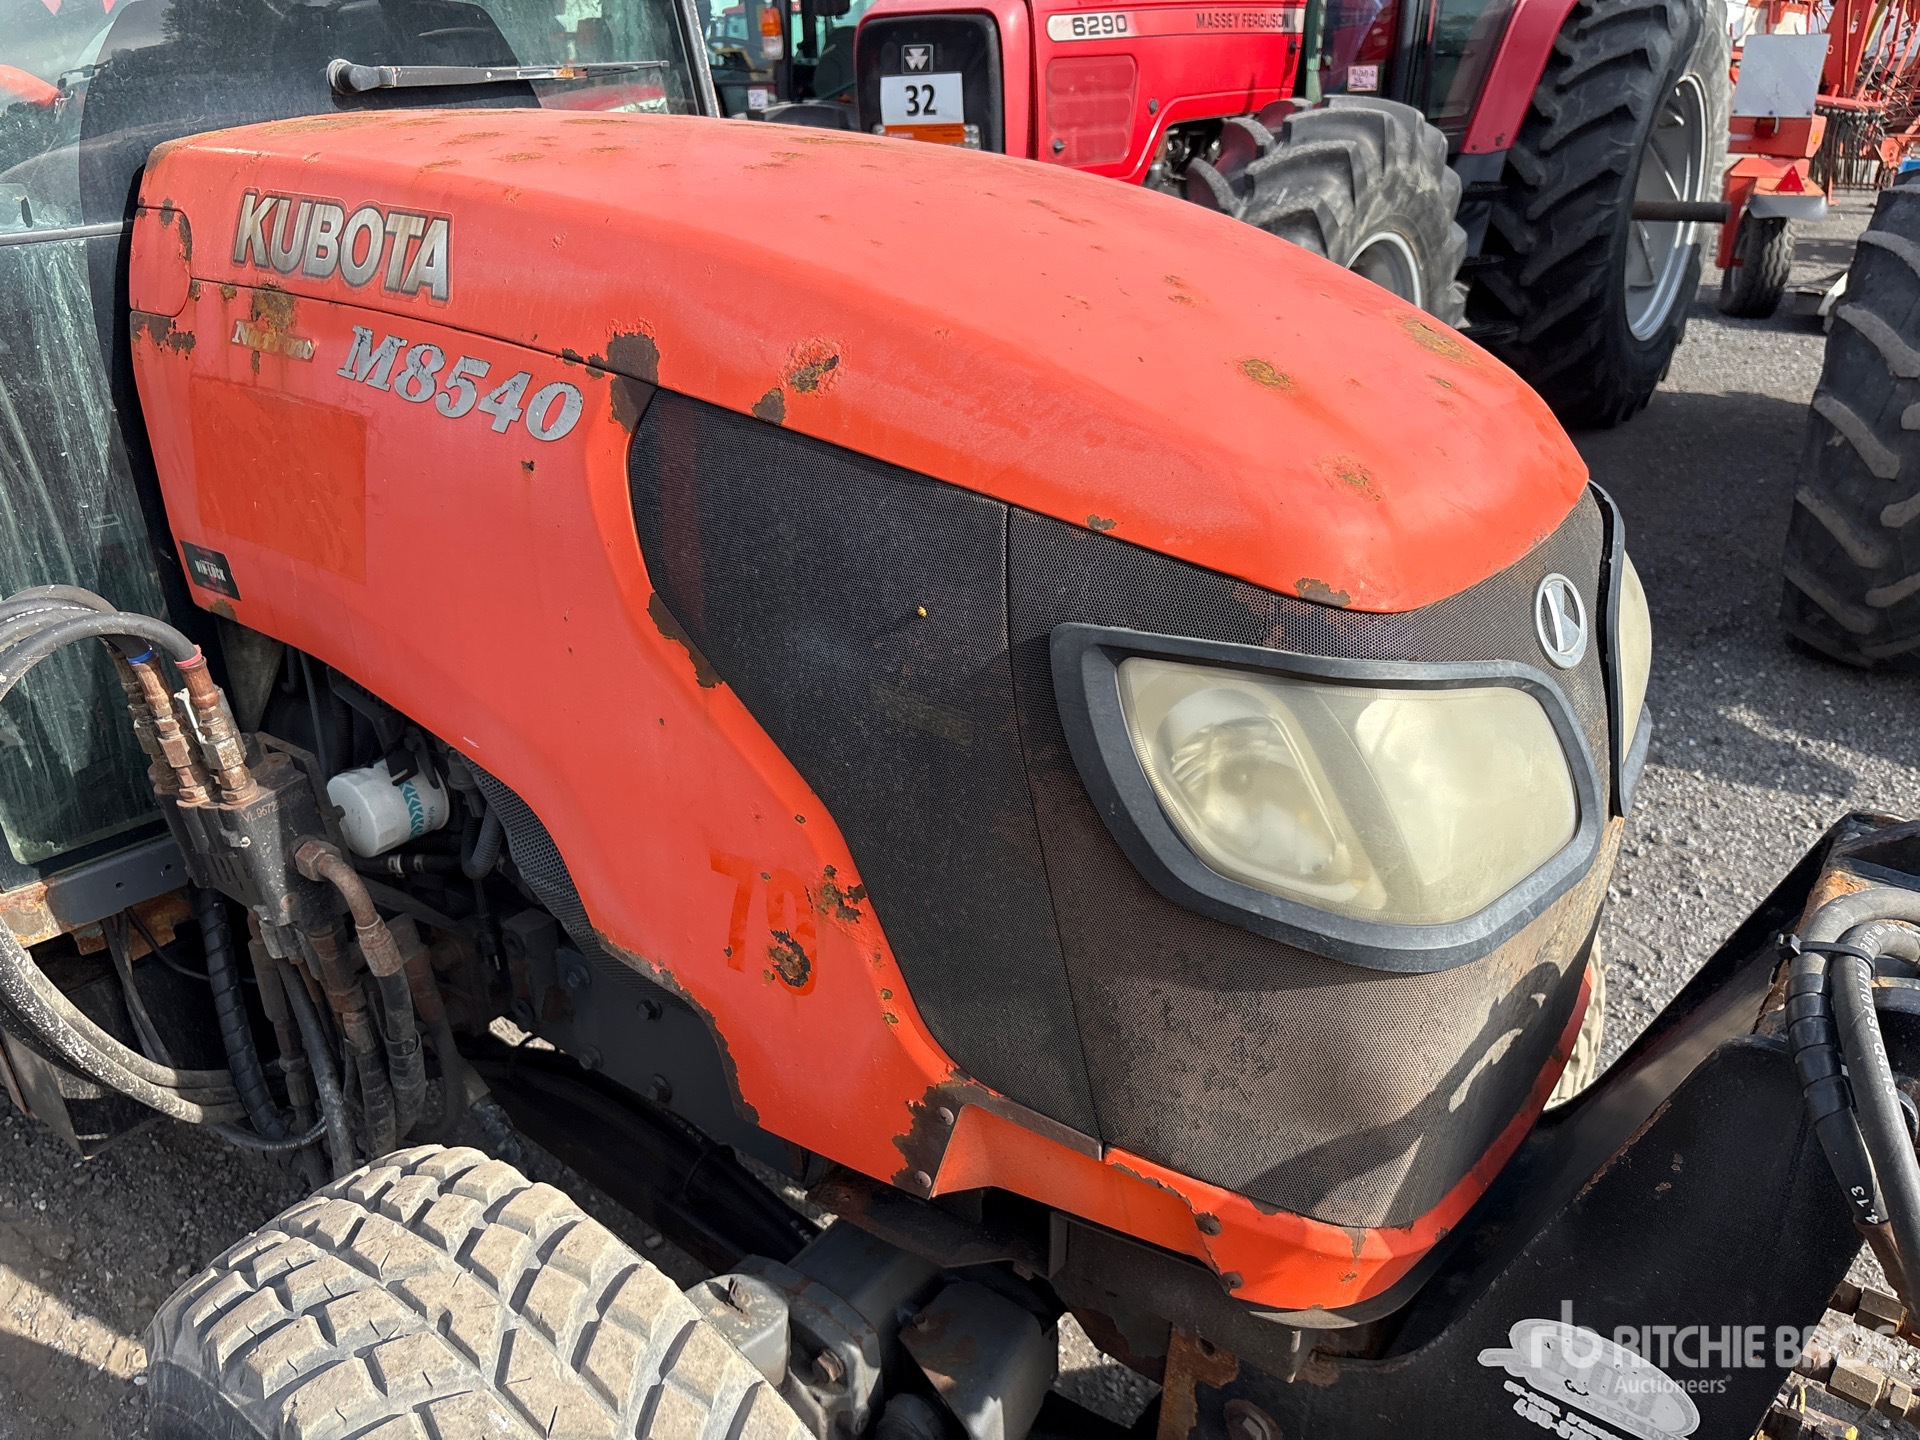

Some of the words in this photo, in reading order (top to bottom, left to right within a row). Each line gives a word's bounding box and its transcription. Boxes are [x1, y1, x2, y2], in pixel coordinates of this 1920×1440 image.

[1072, 14, 1128, 37] 6290
[1196, 12, 1240, 29] MASSEY
[1242, 12, 1290, 29] FERGUSON
[905, 84, 937, 117] 32
[232, 191, 452, 302] KUBOTA
[337, 324, 584, 442] M8540
